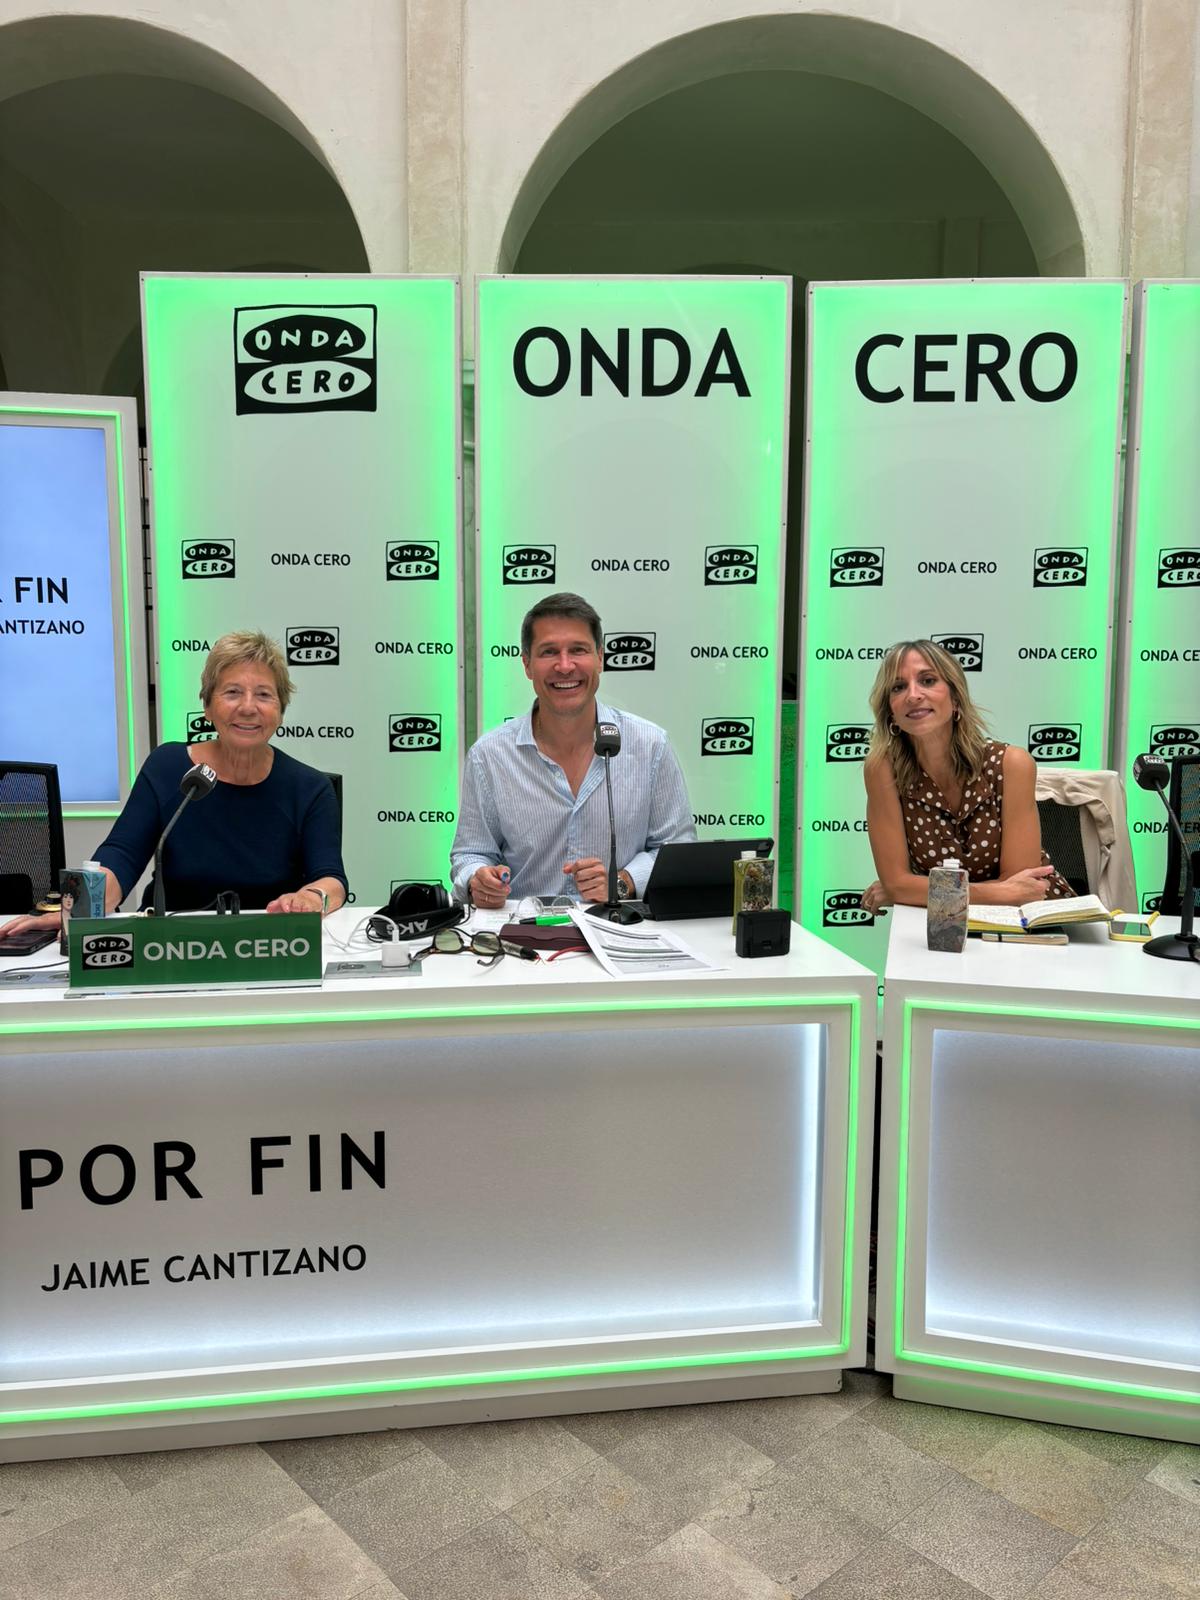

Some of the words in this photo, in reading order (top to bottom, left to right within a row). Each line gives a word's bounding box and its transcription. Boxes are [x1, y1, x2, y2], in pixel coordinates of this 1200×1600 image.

[255, 329, 354, 350] ONDA
[513, 326, 752, 398] ONDA
[855, 332, 1078, 404] CERO
[261, 370, 355, 395] CERO
[189, 548, 226, 556] ONDA
[394, 549, 431, 558] ONDA
[271, 553, 311, 566] ONDA
[314, 553, 351, 566] CERO
[510, 553, 547, 562] ONDA
[712, 554, 750, 562] ONDA
[838, 556, 875, 564] ONDA
[1042, 556, 1079, 565] ONDA
[192, 562, 227, 572] CERO
[396, 564, 432, 574] CERO
[591, 559, 630, 572] ONDA
[633, 559, 670, 572] CERO
[917, 561, 957, 574] ONDA
[960, 561, 997, 574] CERO
[512, 568, 548, 578] CERO
[714, 568, 750, 579] CERO
[840, 570, 875, 580] CERO
[1043, 570, 1079, 580] CERO
[14, 576, 68, 604] FIN
[0, 619, 85, 635] NTIZANO
[294, 635, 331, 644] ONDA
[171, 639, 211, 652] ONDA
[374, 641, 414, 654] ONDA
[417, 642, 454, 655] CERO
[611, 641, 647, 649] ONDA
[296, 650, 332, 659] CERO
[490, 645, 522, 658] OND
[690, 646, 729, 658] ONDA
[732, 646, 769, 658] CERO
[815, 648, 854, 660] ONDA
[1018, 647, 1058, 660] ONDA
[1060, 647, 1098, 660] CERO
[1140, 649, 1179, 662] ONDA
[1182, 649, 1200, 662] CE
[612, 655, 648, 665] CERO
[396, 722, 433, 730] ONDA
[709, 726, 746, 734] ONDA
[275, 726, 315, 738] ONDA
[317, 726, 354, 738] CERO
[1036, 732, 1073, 740] ONDA
[1158, 732, 1194, 741] ONDA
[398, 736, 434, 746] CERO
[711, 740, 746, 749] CERO
[1037, 746, 1073, 756] CERO
[1159, 746, 1194, 756] CERO
[377, 810, 416, 822] ONDA
[418, 810, 455, 823] CERO
[729, 814, 765, 826] CERO
[812, 820, 850, 832] ONDA
[853, 820, 869, 832] CE
[830, 897, 862, 906] OND
[832, 911, 867, 920] CERO
[89, 941, 126, 949] ONDA
[143, 940, 228, 961] ONDA
[234, 937, 311, 958] CERO
[91, 954, 126, 964] CERO
[18, 1140, 203, 1210] POR
[250, 1130, 386, 1196] FIN
[41, 1258, 150, 1292] JAIME
[164, 1244, 366, 1283] CANTIZANO
